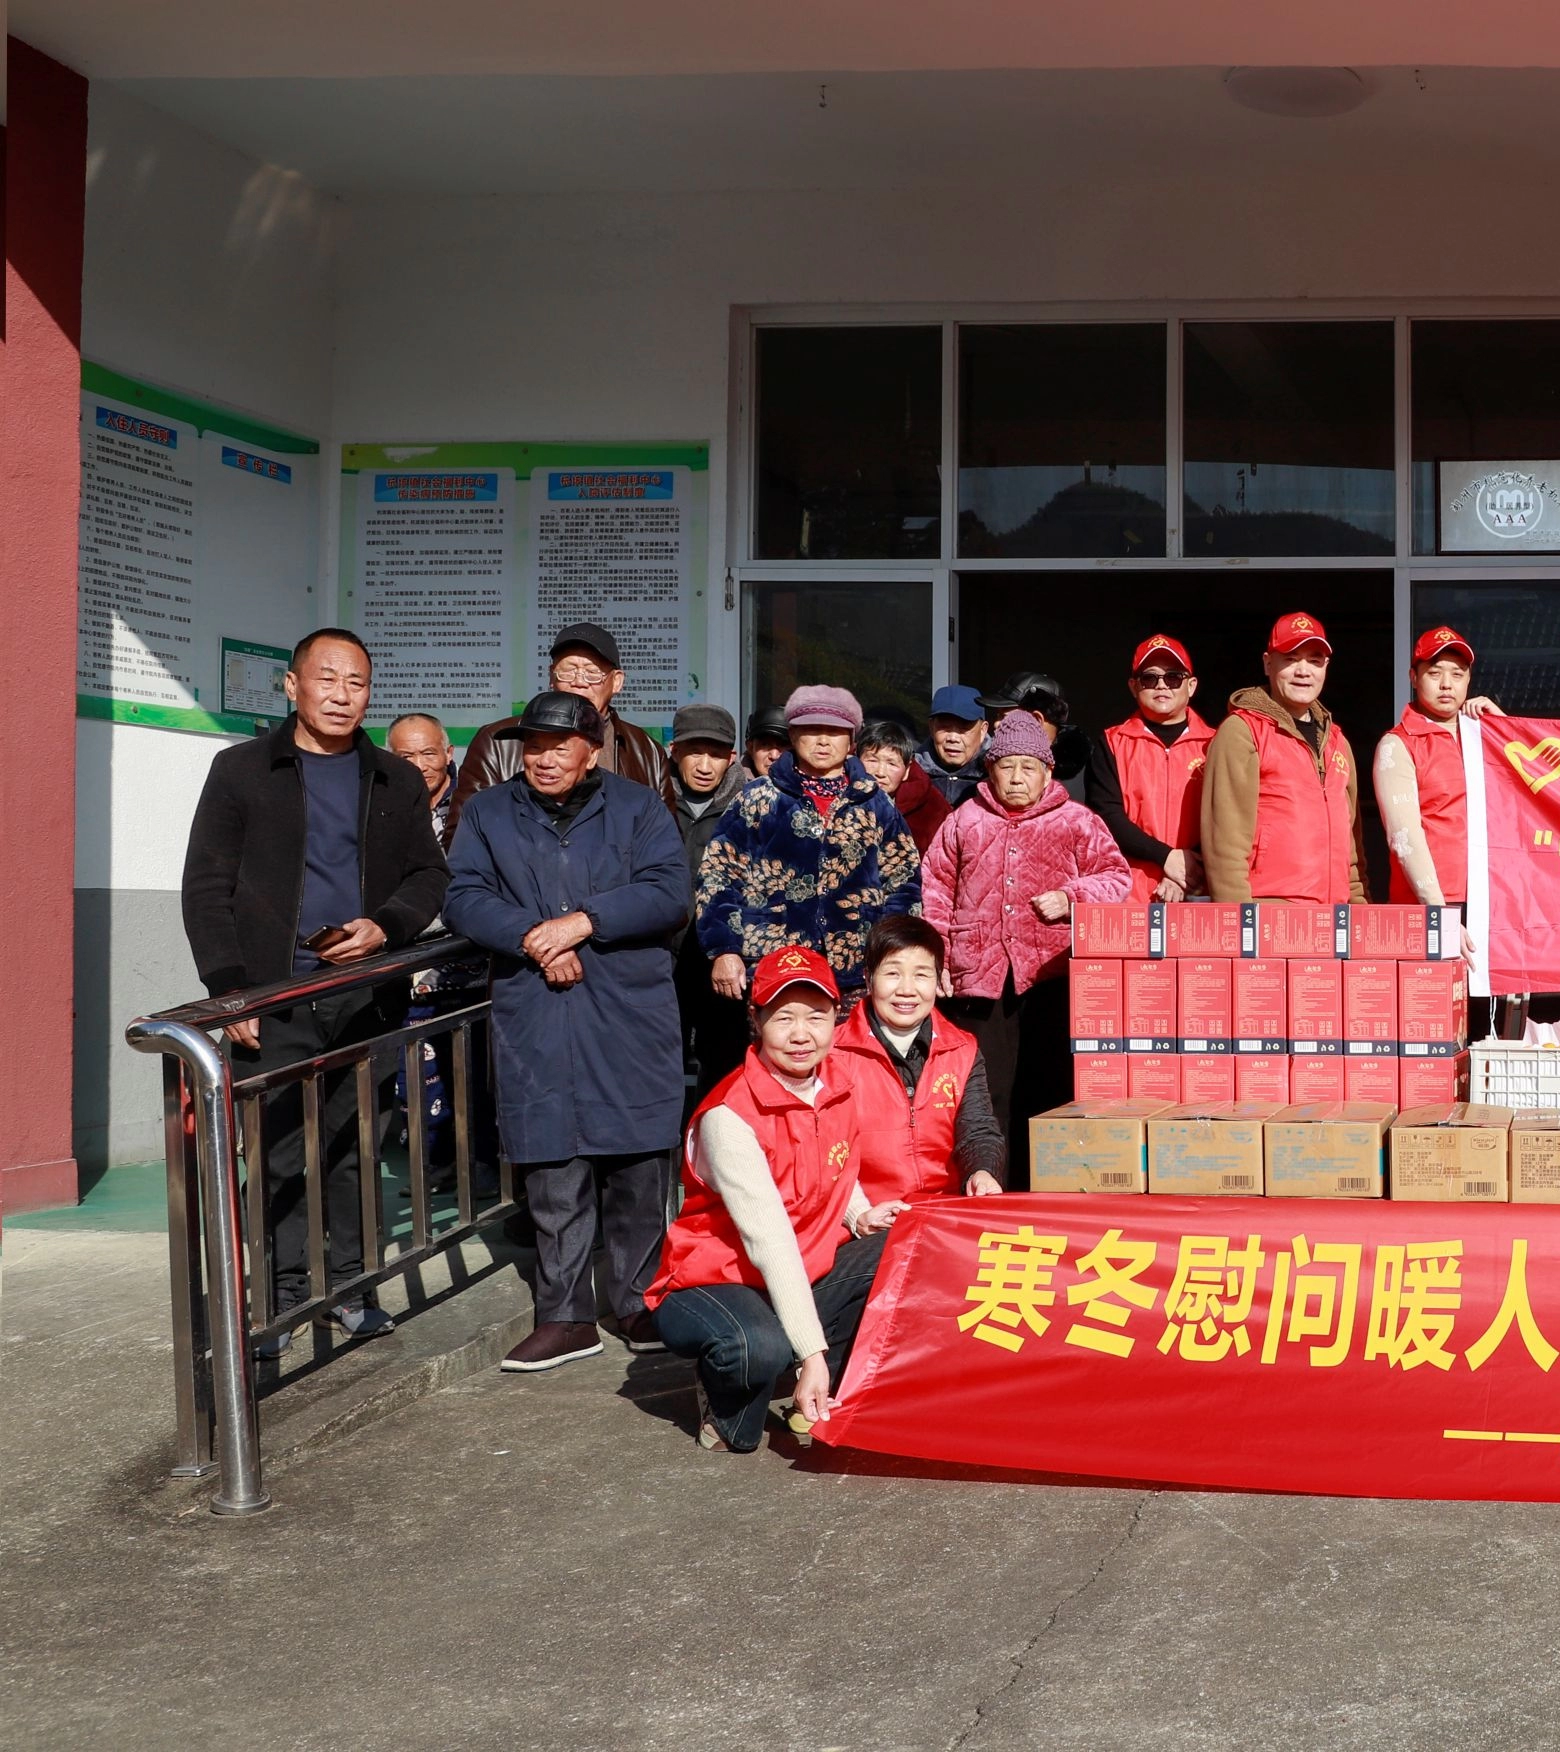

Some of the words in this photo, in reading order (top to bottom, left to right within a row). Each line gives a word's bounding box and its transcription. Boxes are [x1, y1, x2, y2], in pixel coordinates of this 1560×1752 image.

[105, 412, 171, 446] 入住人员守则
[236, 453, 280, 479] 宣传栏
